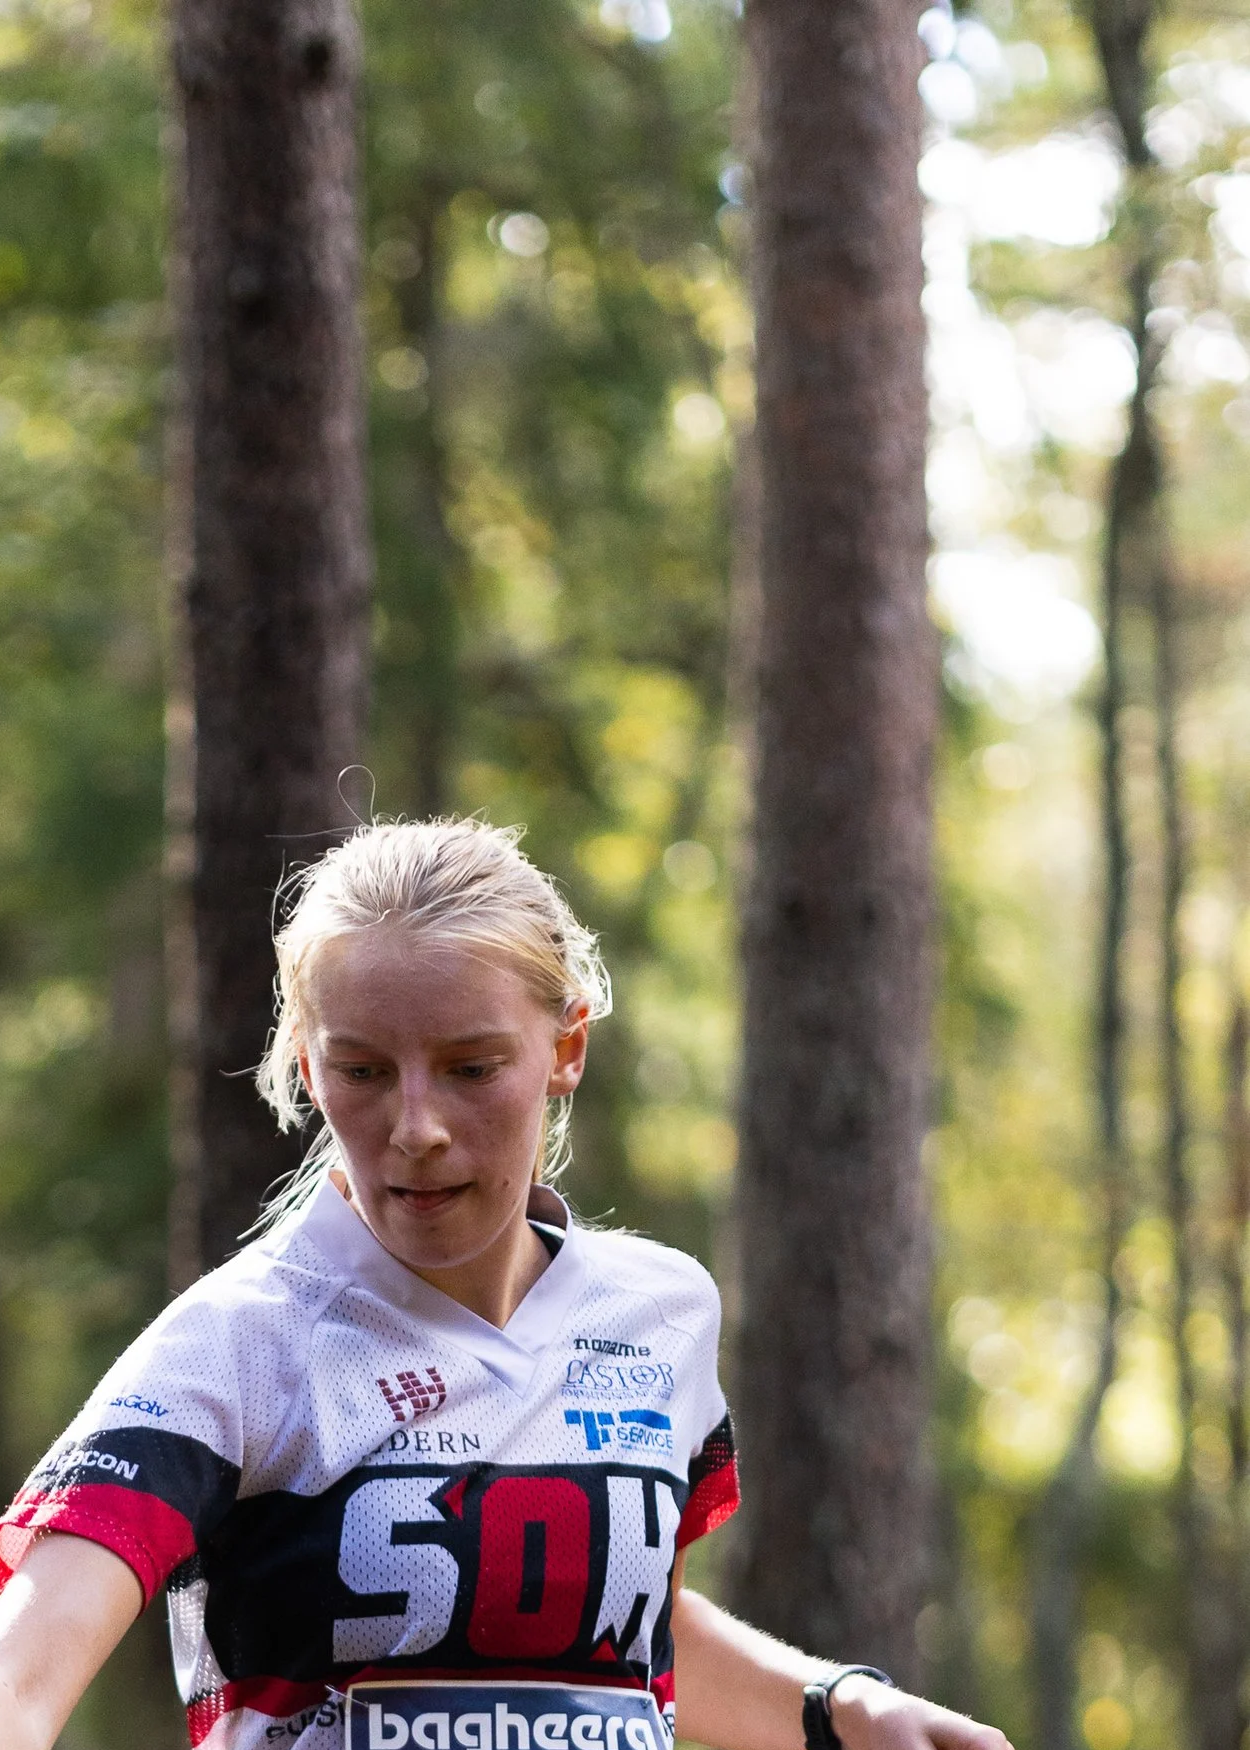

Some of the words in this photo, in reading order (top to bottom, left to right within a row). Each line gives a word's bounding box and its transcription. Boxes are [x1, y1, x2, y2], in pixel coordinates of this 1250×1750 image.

[573, 1337, 651, 1358] noname
[565, 1359, 675, 1390] CASTOR
[372, 1429, 481, 1454] DERN
[616, 1426, 674, 1450] SERVICE
